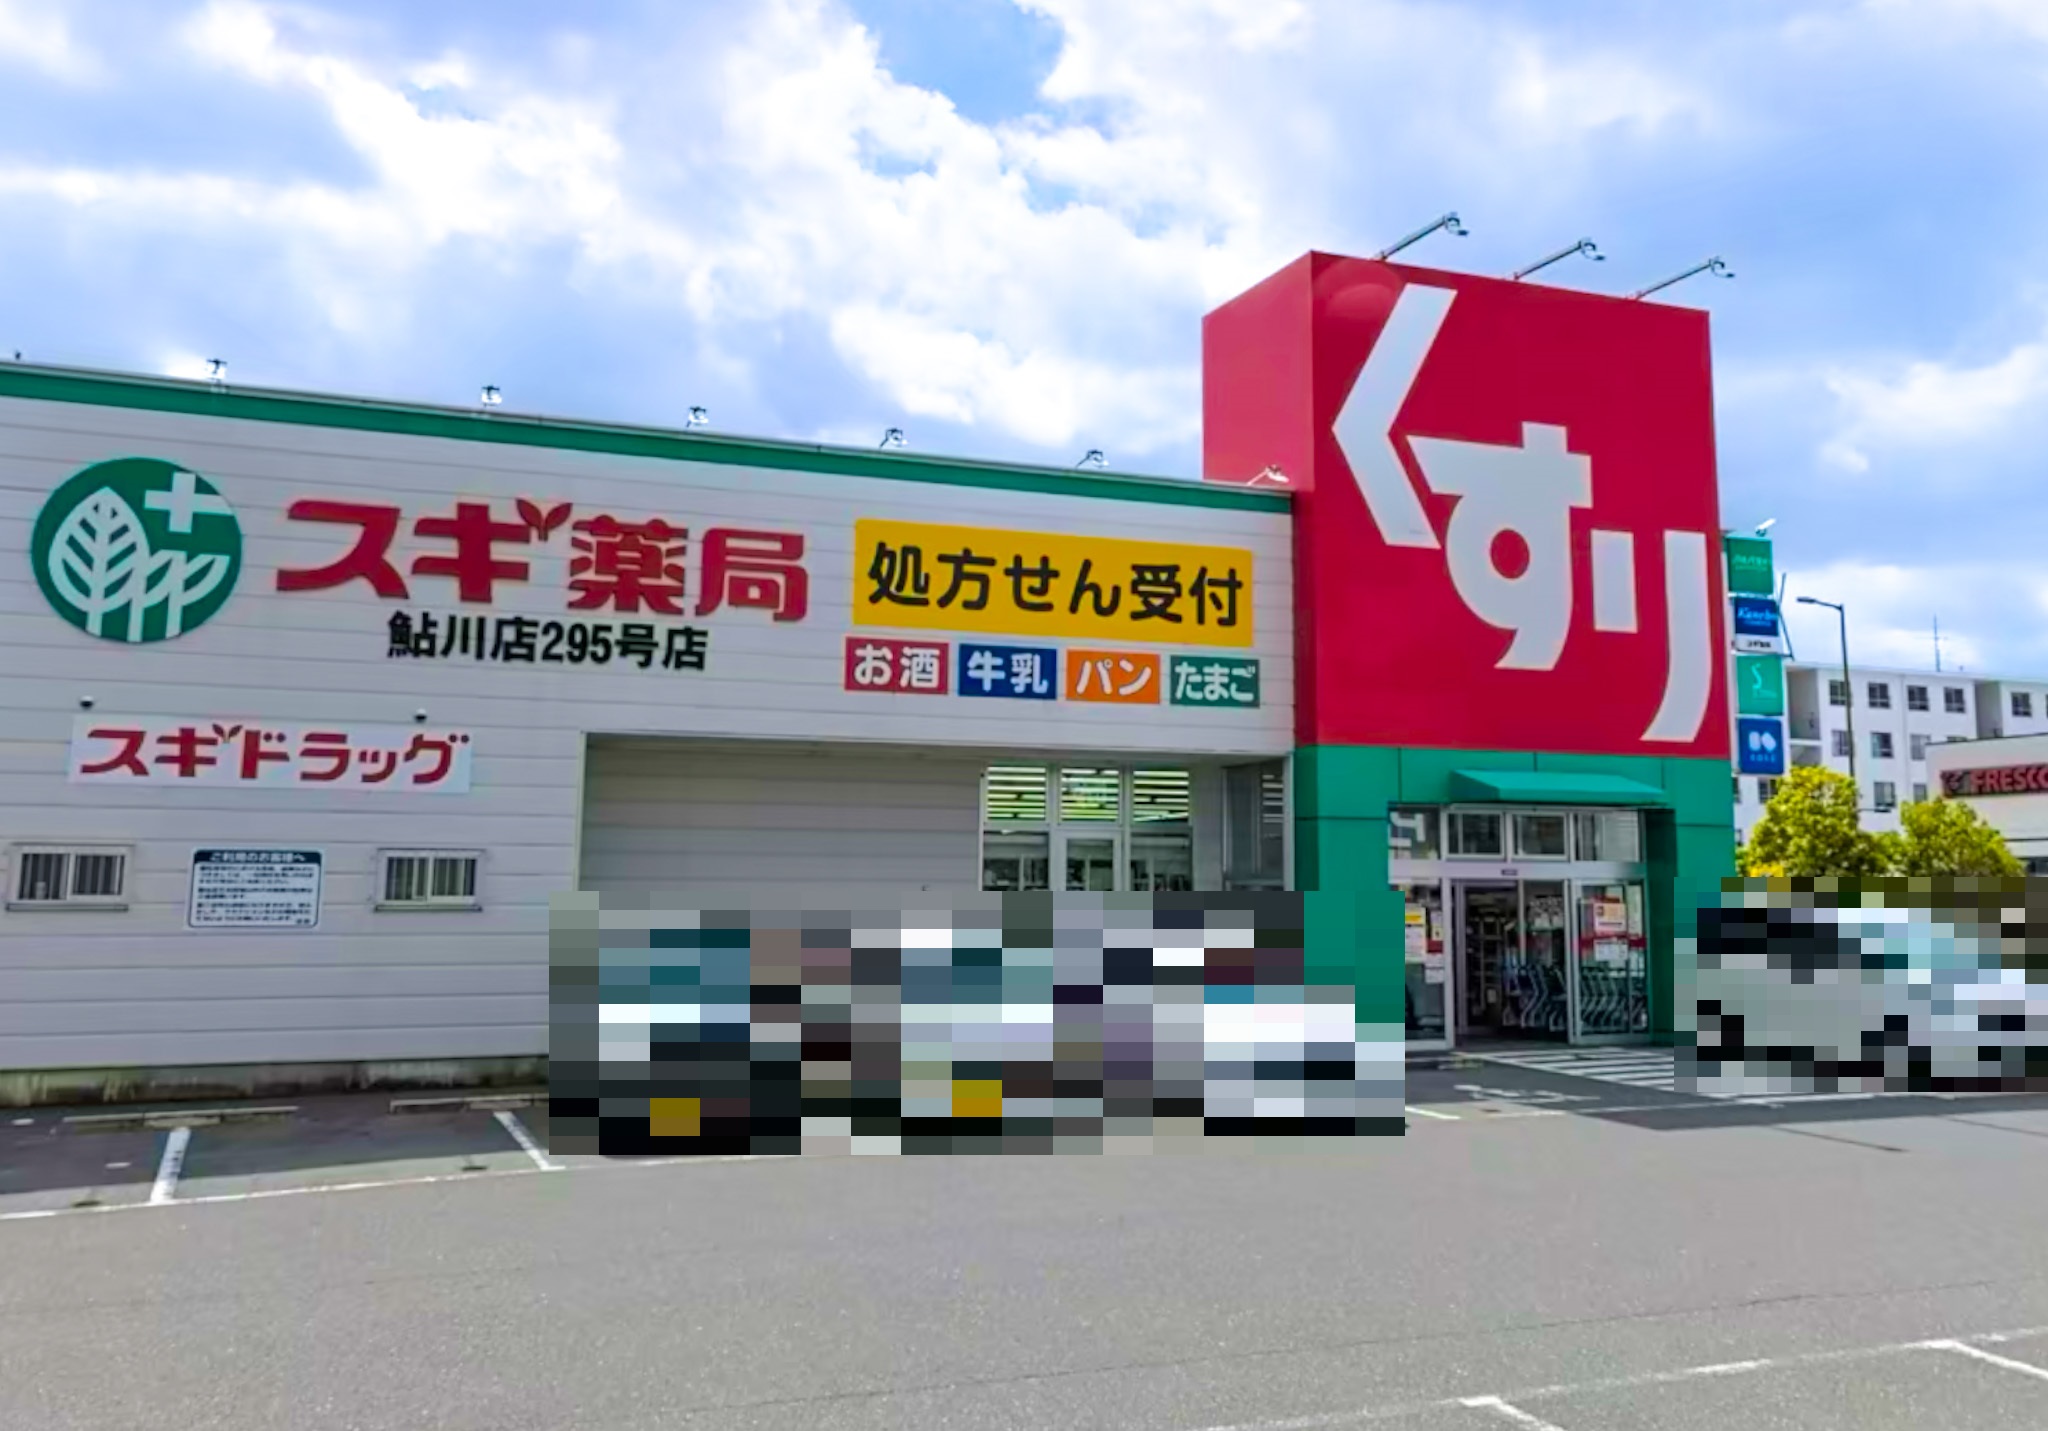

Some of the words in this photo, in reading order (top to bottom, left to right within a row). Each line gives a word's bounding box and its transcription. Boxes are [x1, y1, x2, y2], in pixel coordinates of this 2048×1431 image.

[1331, 282, 1712, 743] くすり
[276, 498, 809, 622] スギ薬局
[868, 540, 1243, 627] 処方せん受付
[387, 611, 709, 670] 鮎川店295号店
[853, 643, 940, 689] お酒
[966, 651, 1049, 694] 牛乳
[1076, 658, 1152, 696] パン
[1174, 660, 1256, 702] たまご
[80, 723, 470, 784] スギドラッグ
